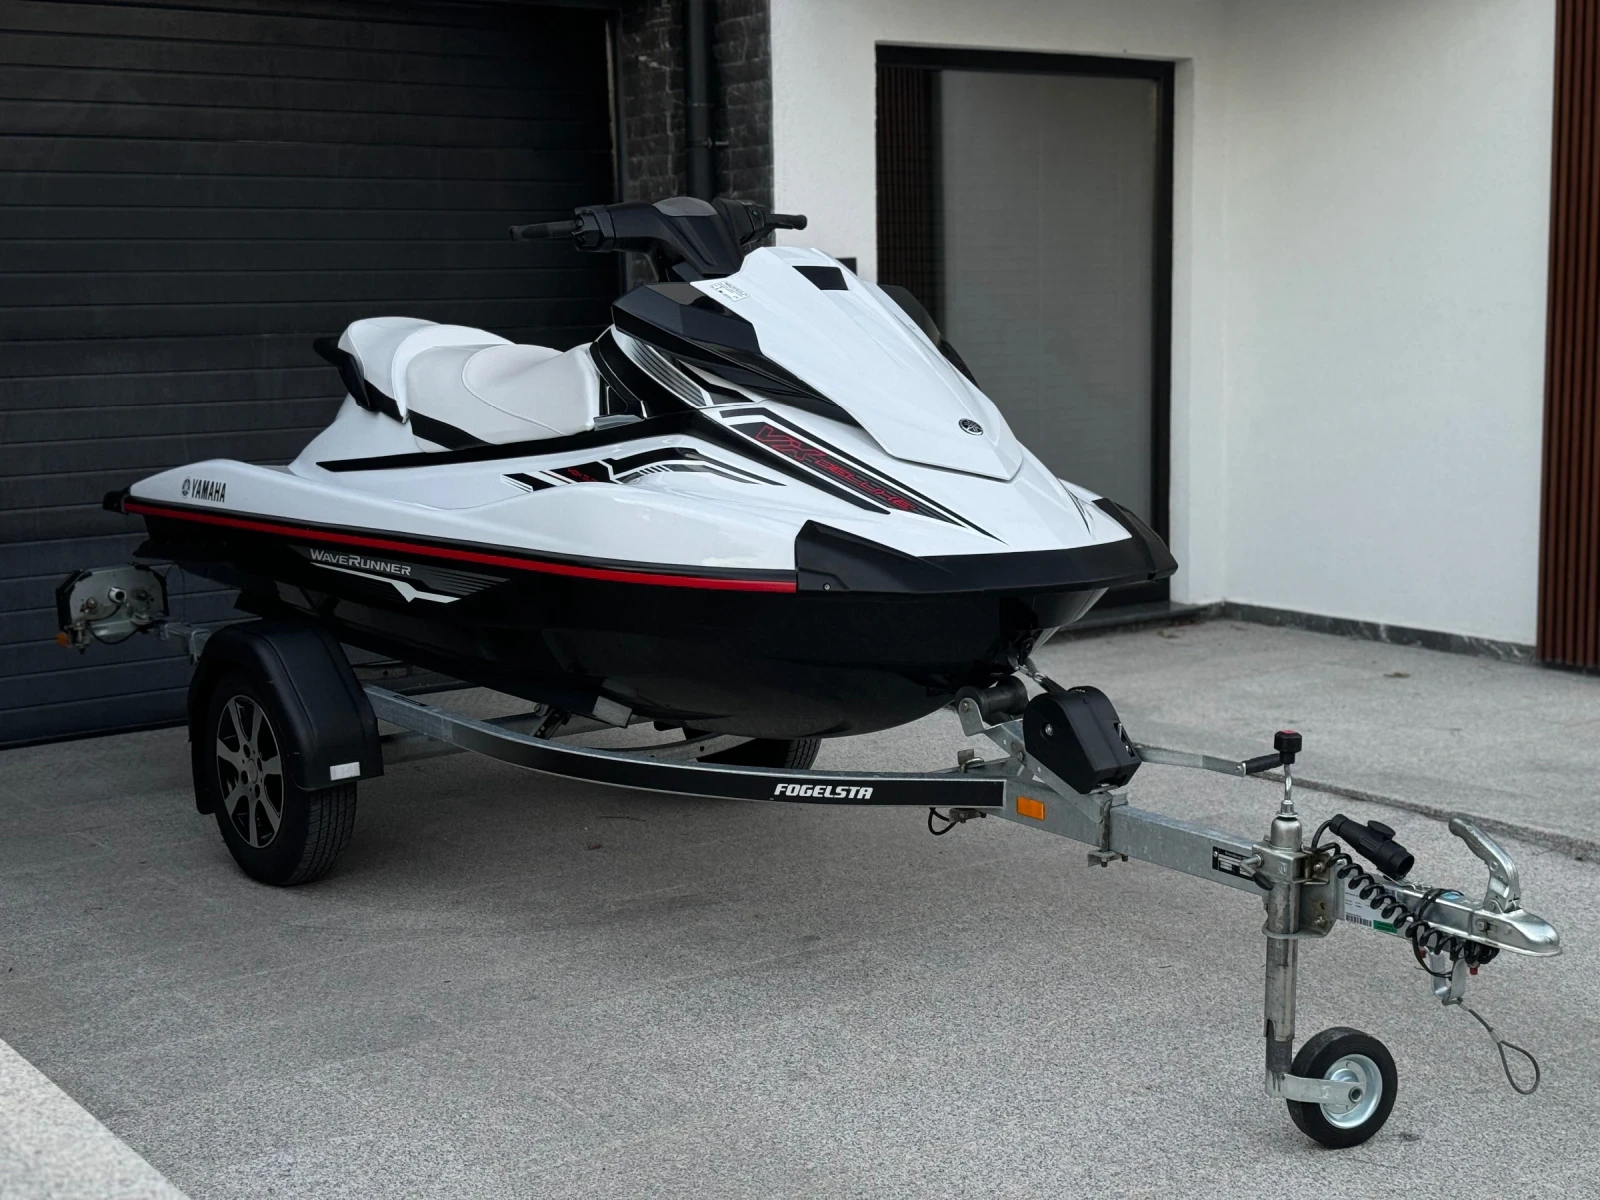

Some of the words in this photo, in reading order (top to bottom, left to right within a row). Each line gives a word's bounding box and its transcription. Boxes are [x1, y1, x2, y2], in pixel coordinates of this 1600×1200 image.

[191, 478, 226, 503] YAMAHA
[310, 548, 411, 576] WAVERUNNER
[774, 783, 874, 799] FOGELSTA
